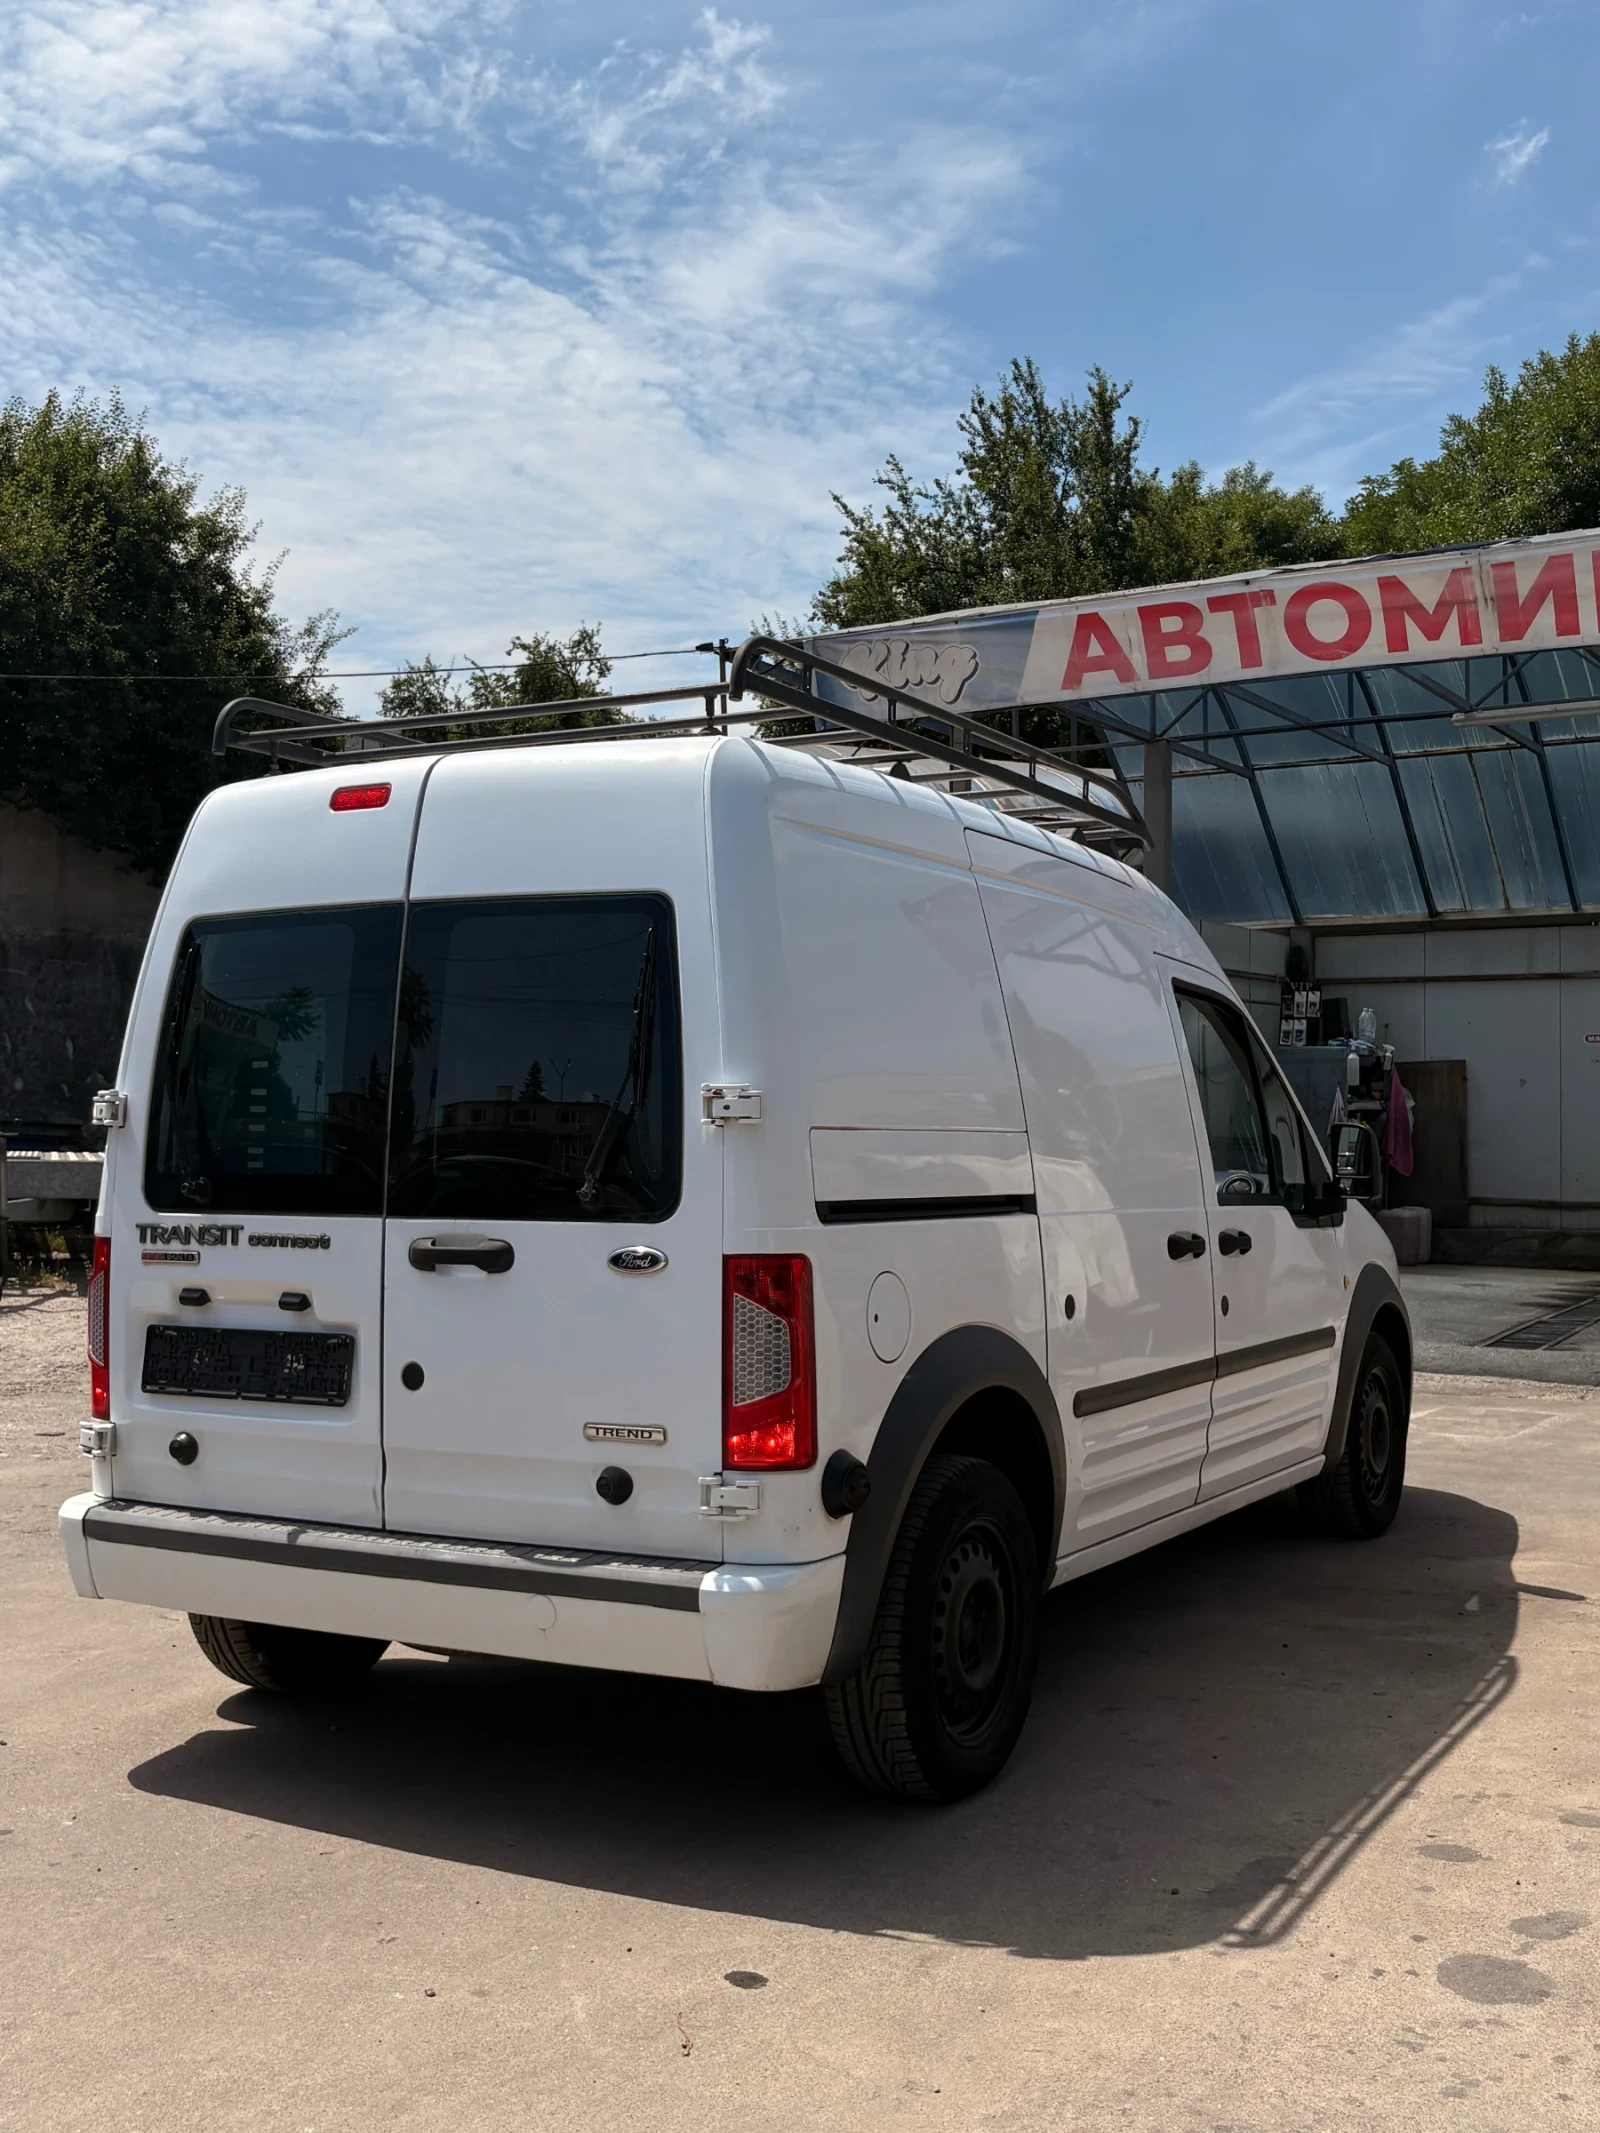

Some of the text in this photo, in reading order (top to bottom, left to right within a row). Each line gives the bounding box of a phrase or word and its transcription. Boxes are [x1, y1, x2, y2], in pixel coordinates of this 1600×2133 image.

[1060, 550, 1600, 691] АВТОМИ
[136, 1223, 331, 1250] TRANSIT connect
[618, 1251, 651, 1268] Ford
[594, 1427, 653, 1439] TREND
